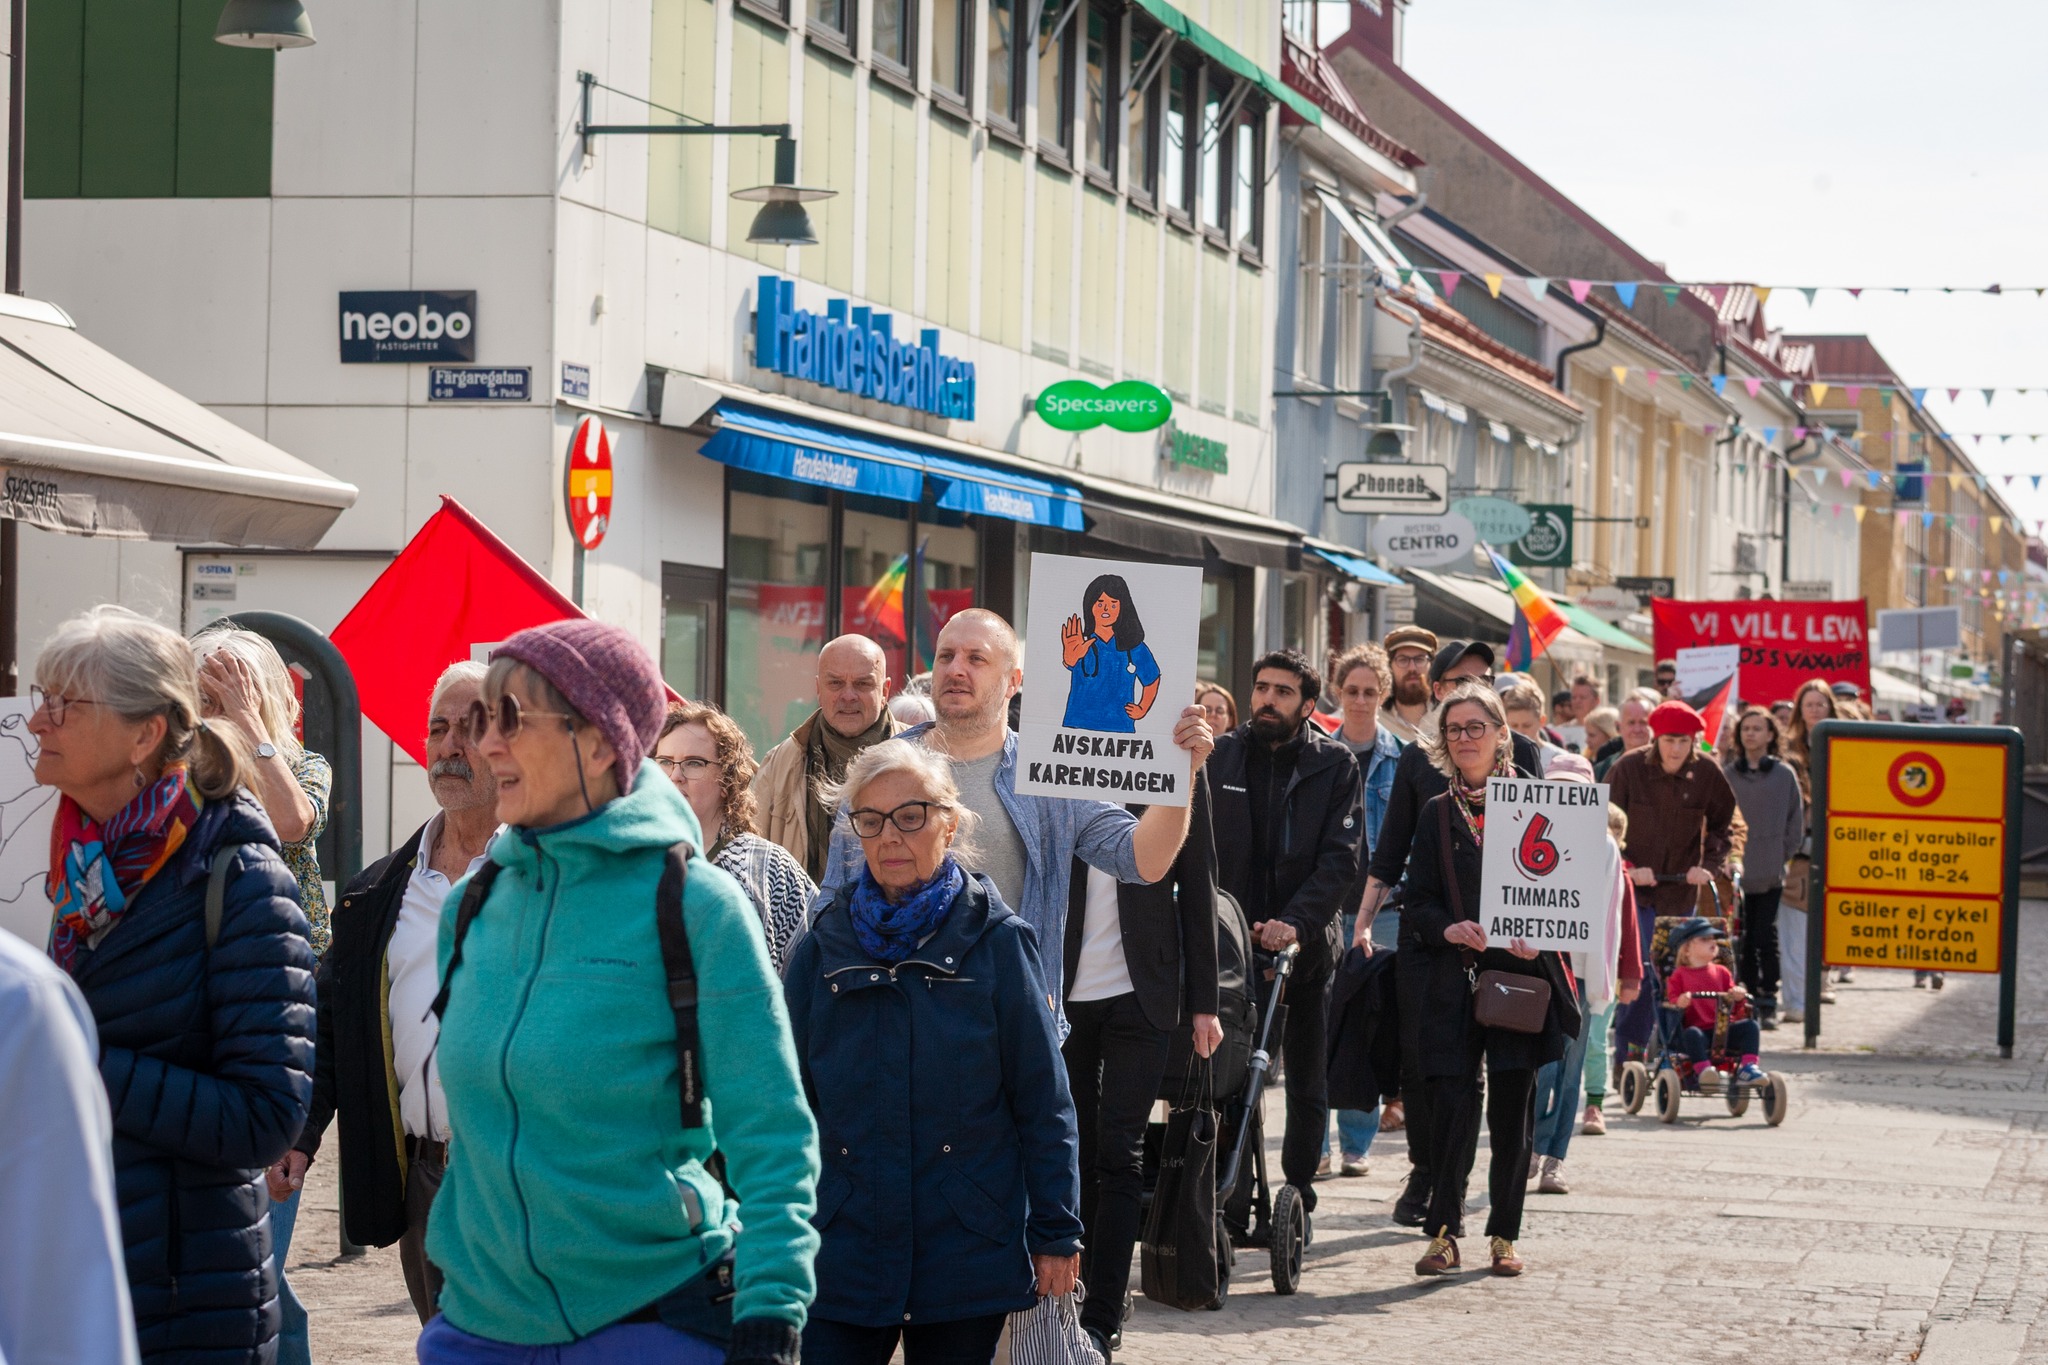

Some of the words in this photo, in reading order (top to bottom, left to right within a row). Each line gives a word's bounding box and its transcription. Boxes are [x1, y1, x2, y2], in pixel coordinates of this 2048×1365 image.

[343, 304, 471, 340] neobo
[375, 342, 439, 351] FASTIGHETER
[757, 275, 975, 421] Handelsbanken
[435, 369, 523, 388] Färgaregatan
[1045, 395, 1158, 415] Specsavers
[792, 449, 858, 487] Handelsbanken
[1357, 472, 1425, 494] Phoneab
[1403, 523, 1441, 534] BISTRO
[1526, 534, 1557, 542] BODY
[1388, 534, 1459, 551] CENTRO
[1528, 543, 1555, 551] SHOP
[206, 565, 233, 574] STENA
[1690, 612, 1719, 637] VI
[1730, 612, 1797, 641] VILL
[1805, 614, 1863, 642] LEVA
[1740, 646, 1781, 667] OSS
[1052, 733, 1154, 760] AVSKAFFA
[1029, 762, 1175, 794] KARENSDAGEN
[1491, 782, 1518, 803] TID
[1523, 784, 1555, 804] ATT
[1558, 786, 1600, 807] LEVA
[1518, 811, 1560, 877] 6
[1834, 827, 1886, 842] Gäller
[1893, 829, 1908, 845] ej
[1916, 832, 1996, 847] varubilar
[1869, 848, 1901, 861] alla
[1908, 849, 1960, 866] dagar
[1502, 885, 1581, 908] TIMMARS
[1838, 900, 1900, 919] Gäller
[1907, 905, 1925, 923] ej
[1934, 907, 1988, 924] cykel
[1490, 916, 1590, 940] ARBETSDAG
[1851, 926, 1899, 939] samt
[1907, 925, 1974, 943] fordon
[1846, 944, 1888, 959] med
[1896, 945, 1977, 964] tillstånd
